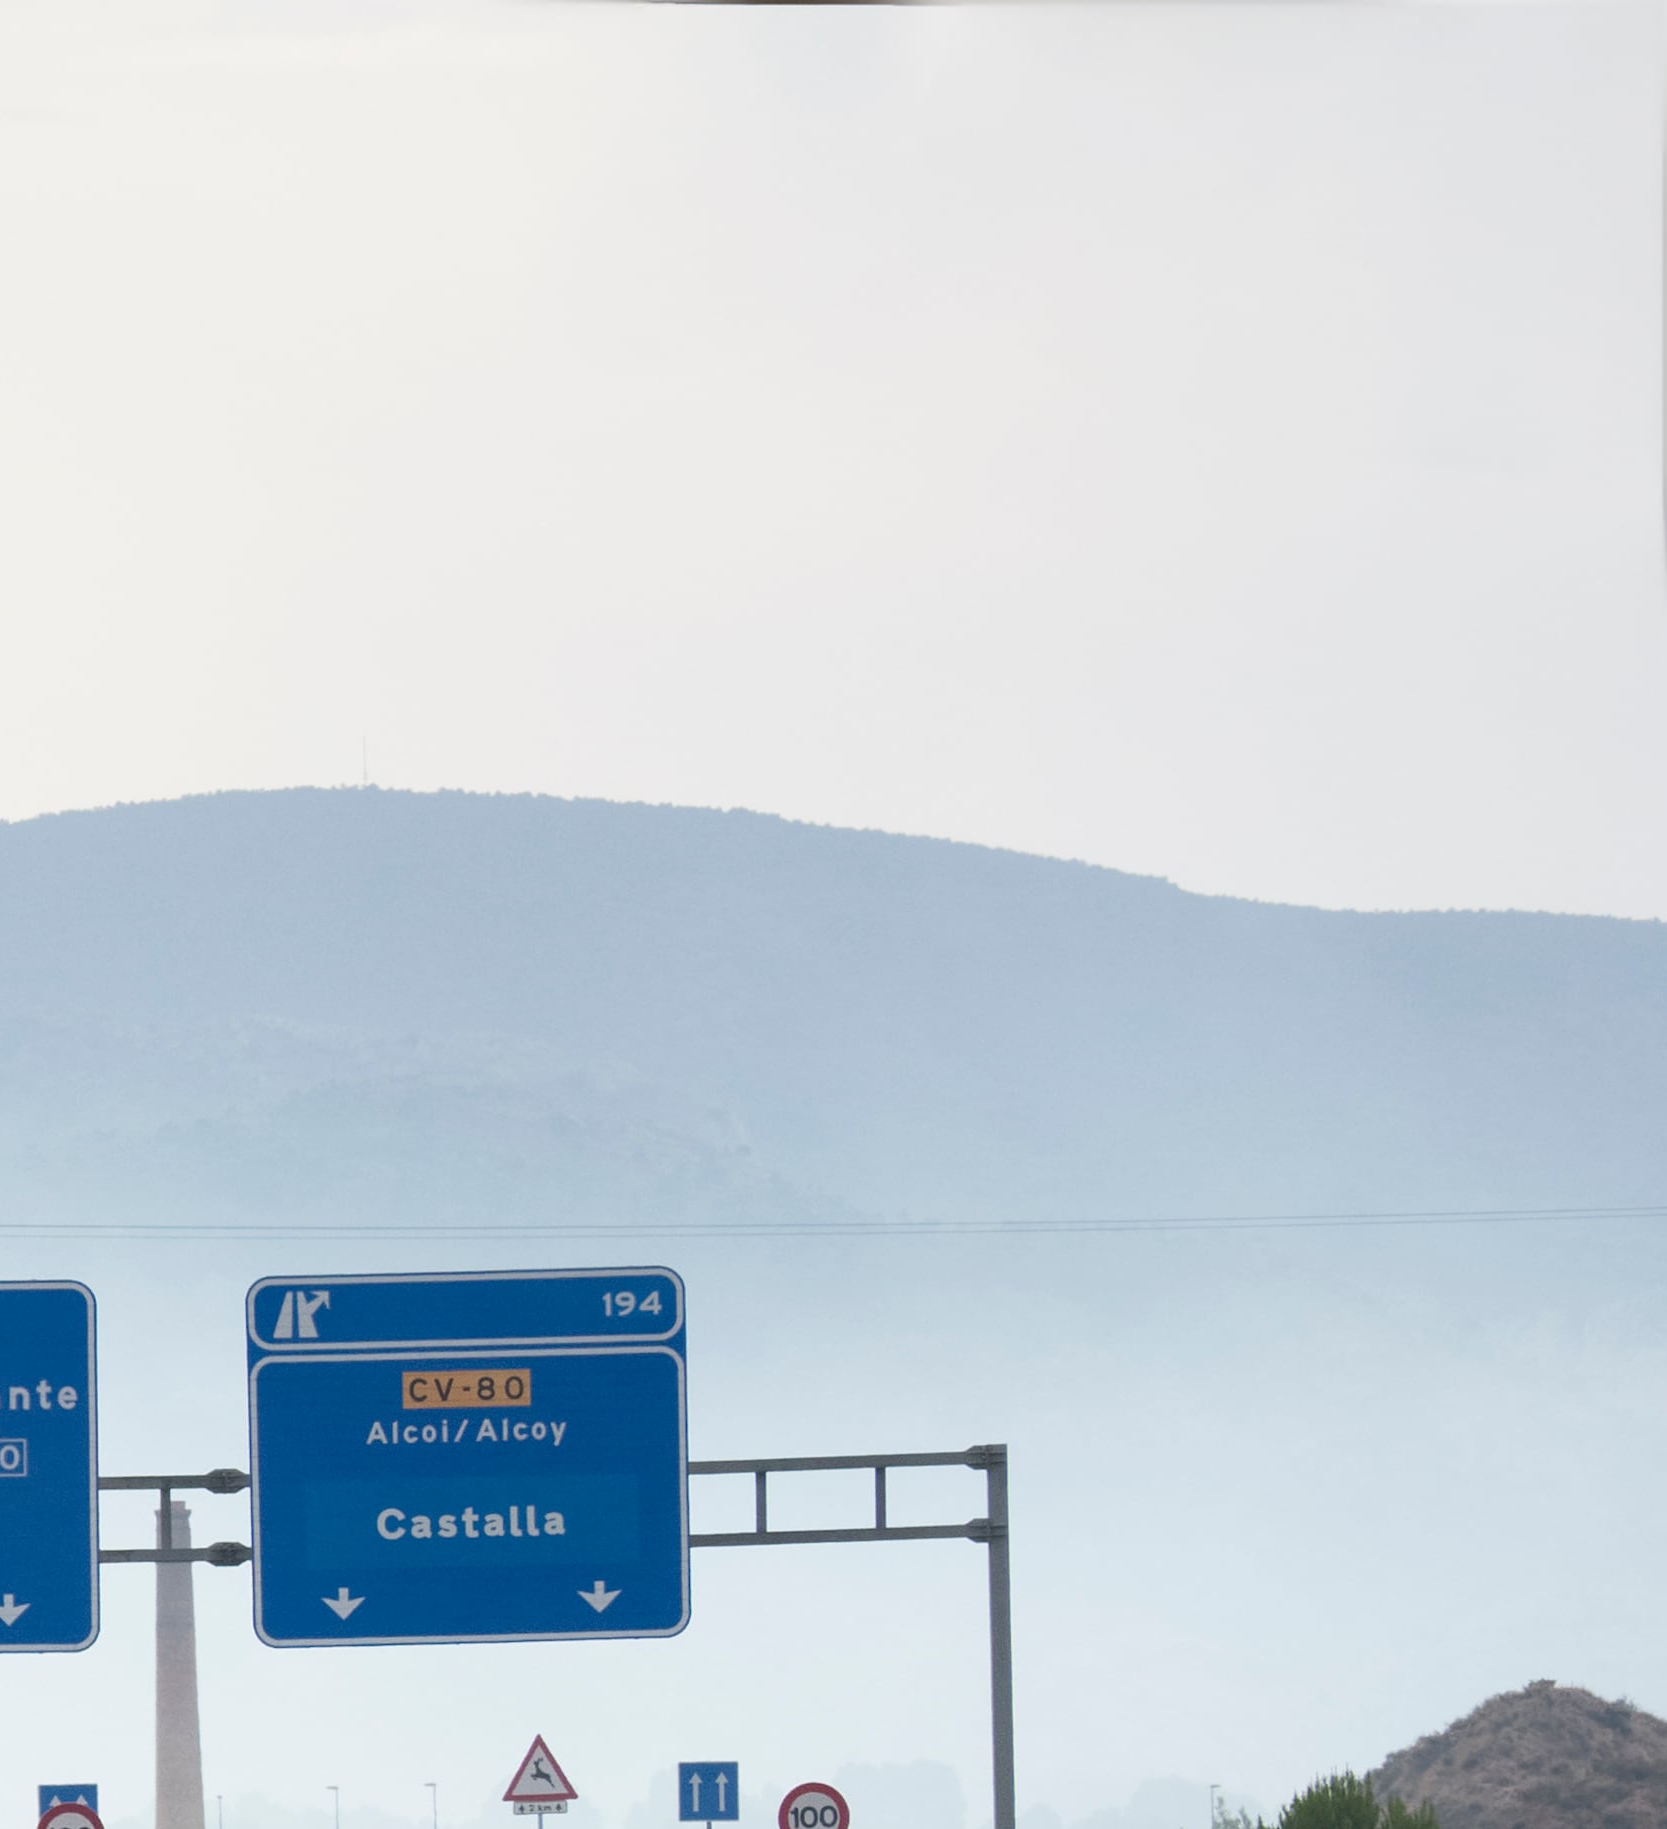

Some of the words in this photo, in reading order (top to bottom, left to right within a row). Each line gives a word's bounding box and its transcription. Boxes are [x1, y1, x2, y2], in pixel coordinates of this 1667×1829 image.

[602, 1291, 662, 1317] 194
[408, 1376, 525, 1402] CV-80
[366, 1418, 567, 1446] Alcoi/Alcoy
[376, 1505, 566, 1540] Castalla
[790, 1805, 839, 1829] 100
